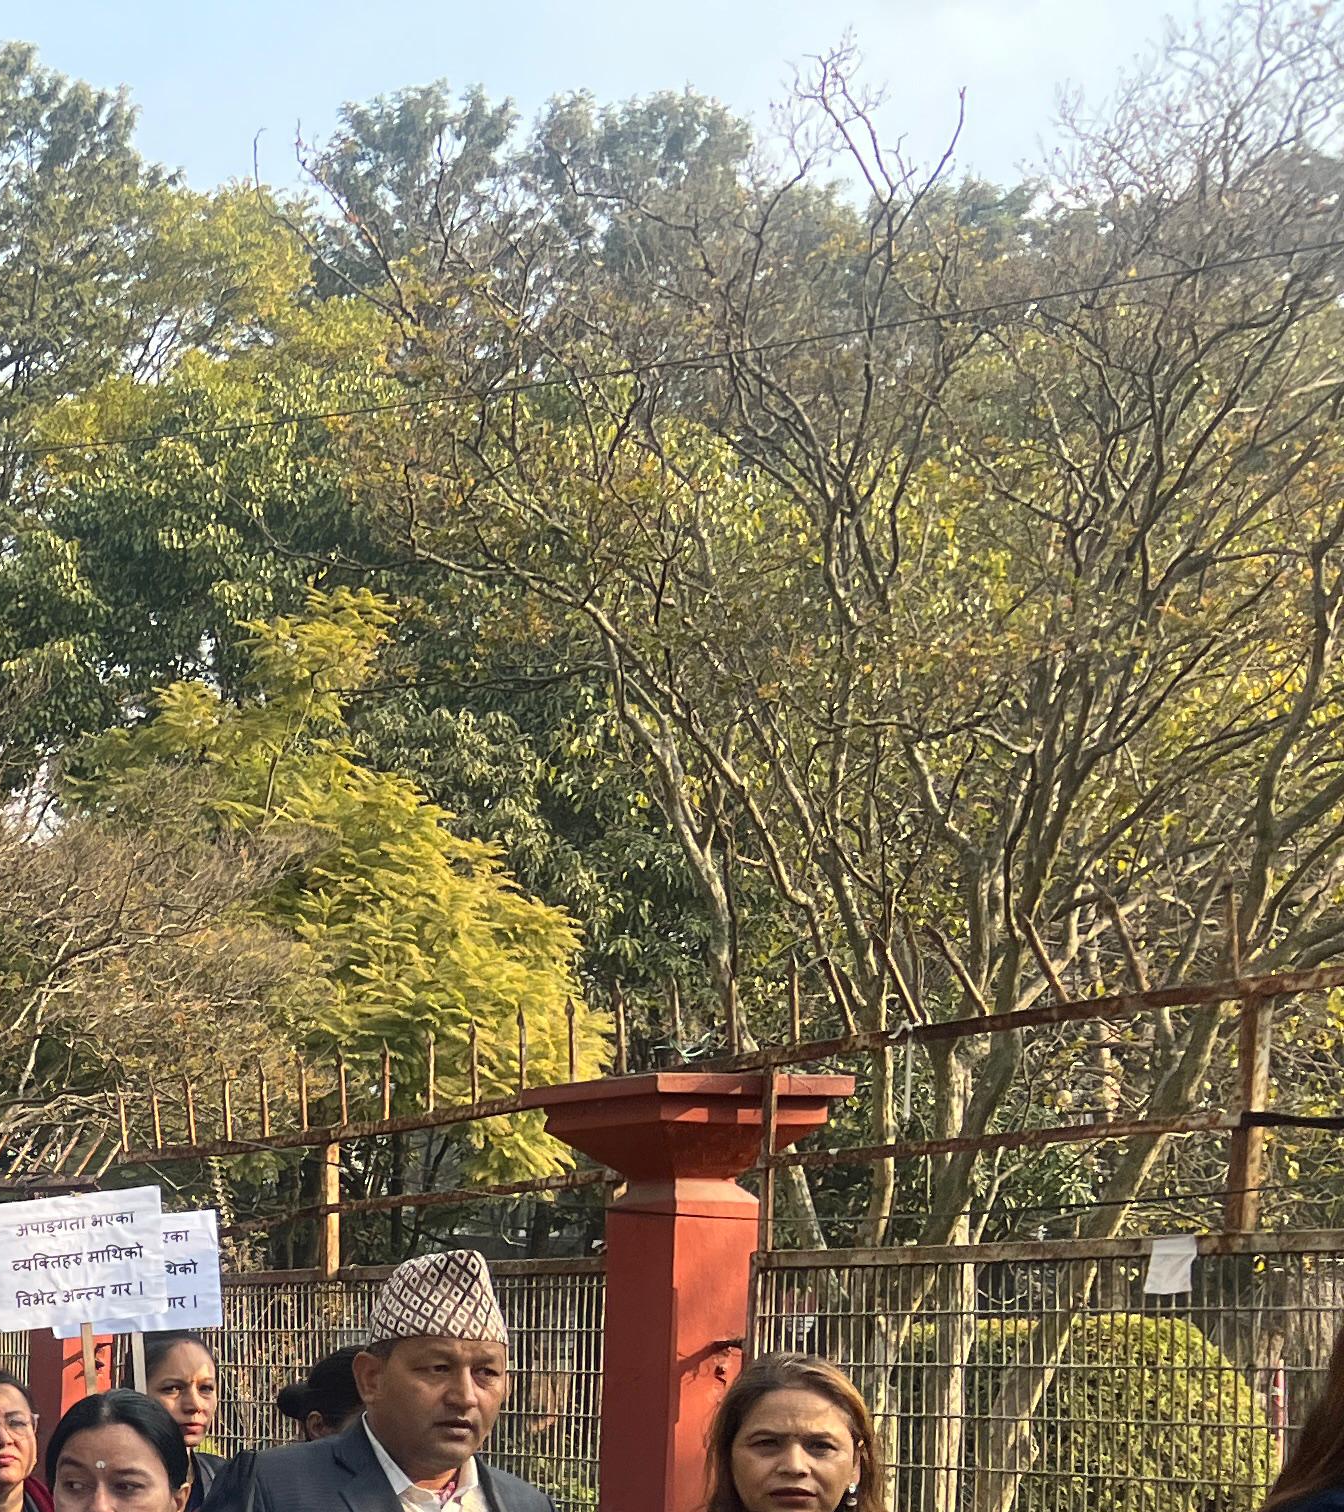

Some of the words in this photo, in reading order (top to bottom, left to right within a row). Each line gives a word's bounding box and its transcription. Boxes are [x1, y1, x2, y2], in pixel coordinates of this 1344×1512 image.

[91, 1211, 134, 1228] भएका
[88, 1243, 143, 1264] माथिको
[16, 1291, 56, 1308] विभेद
[111, 1282, 132, 1296] गर
